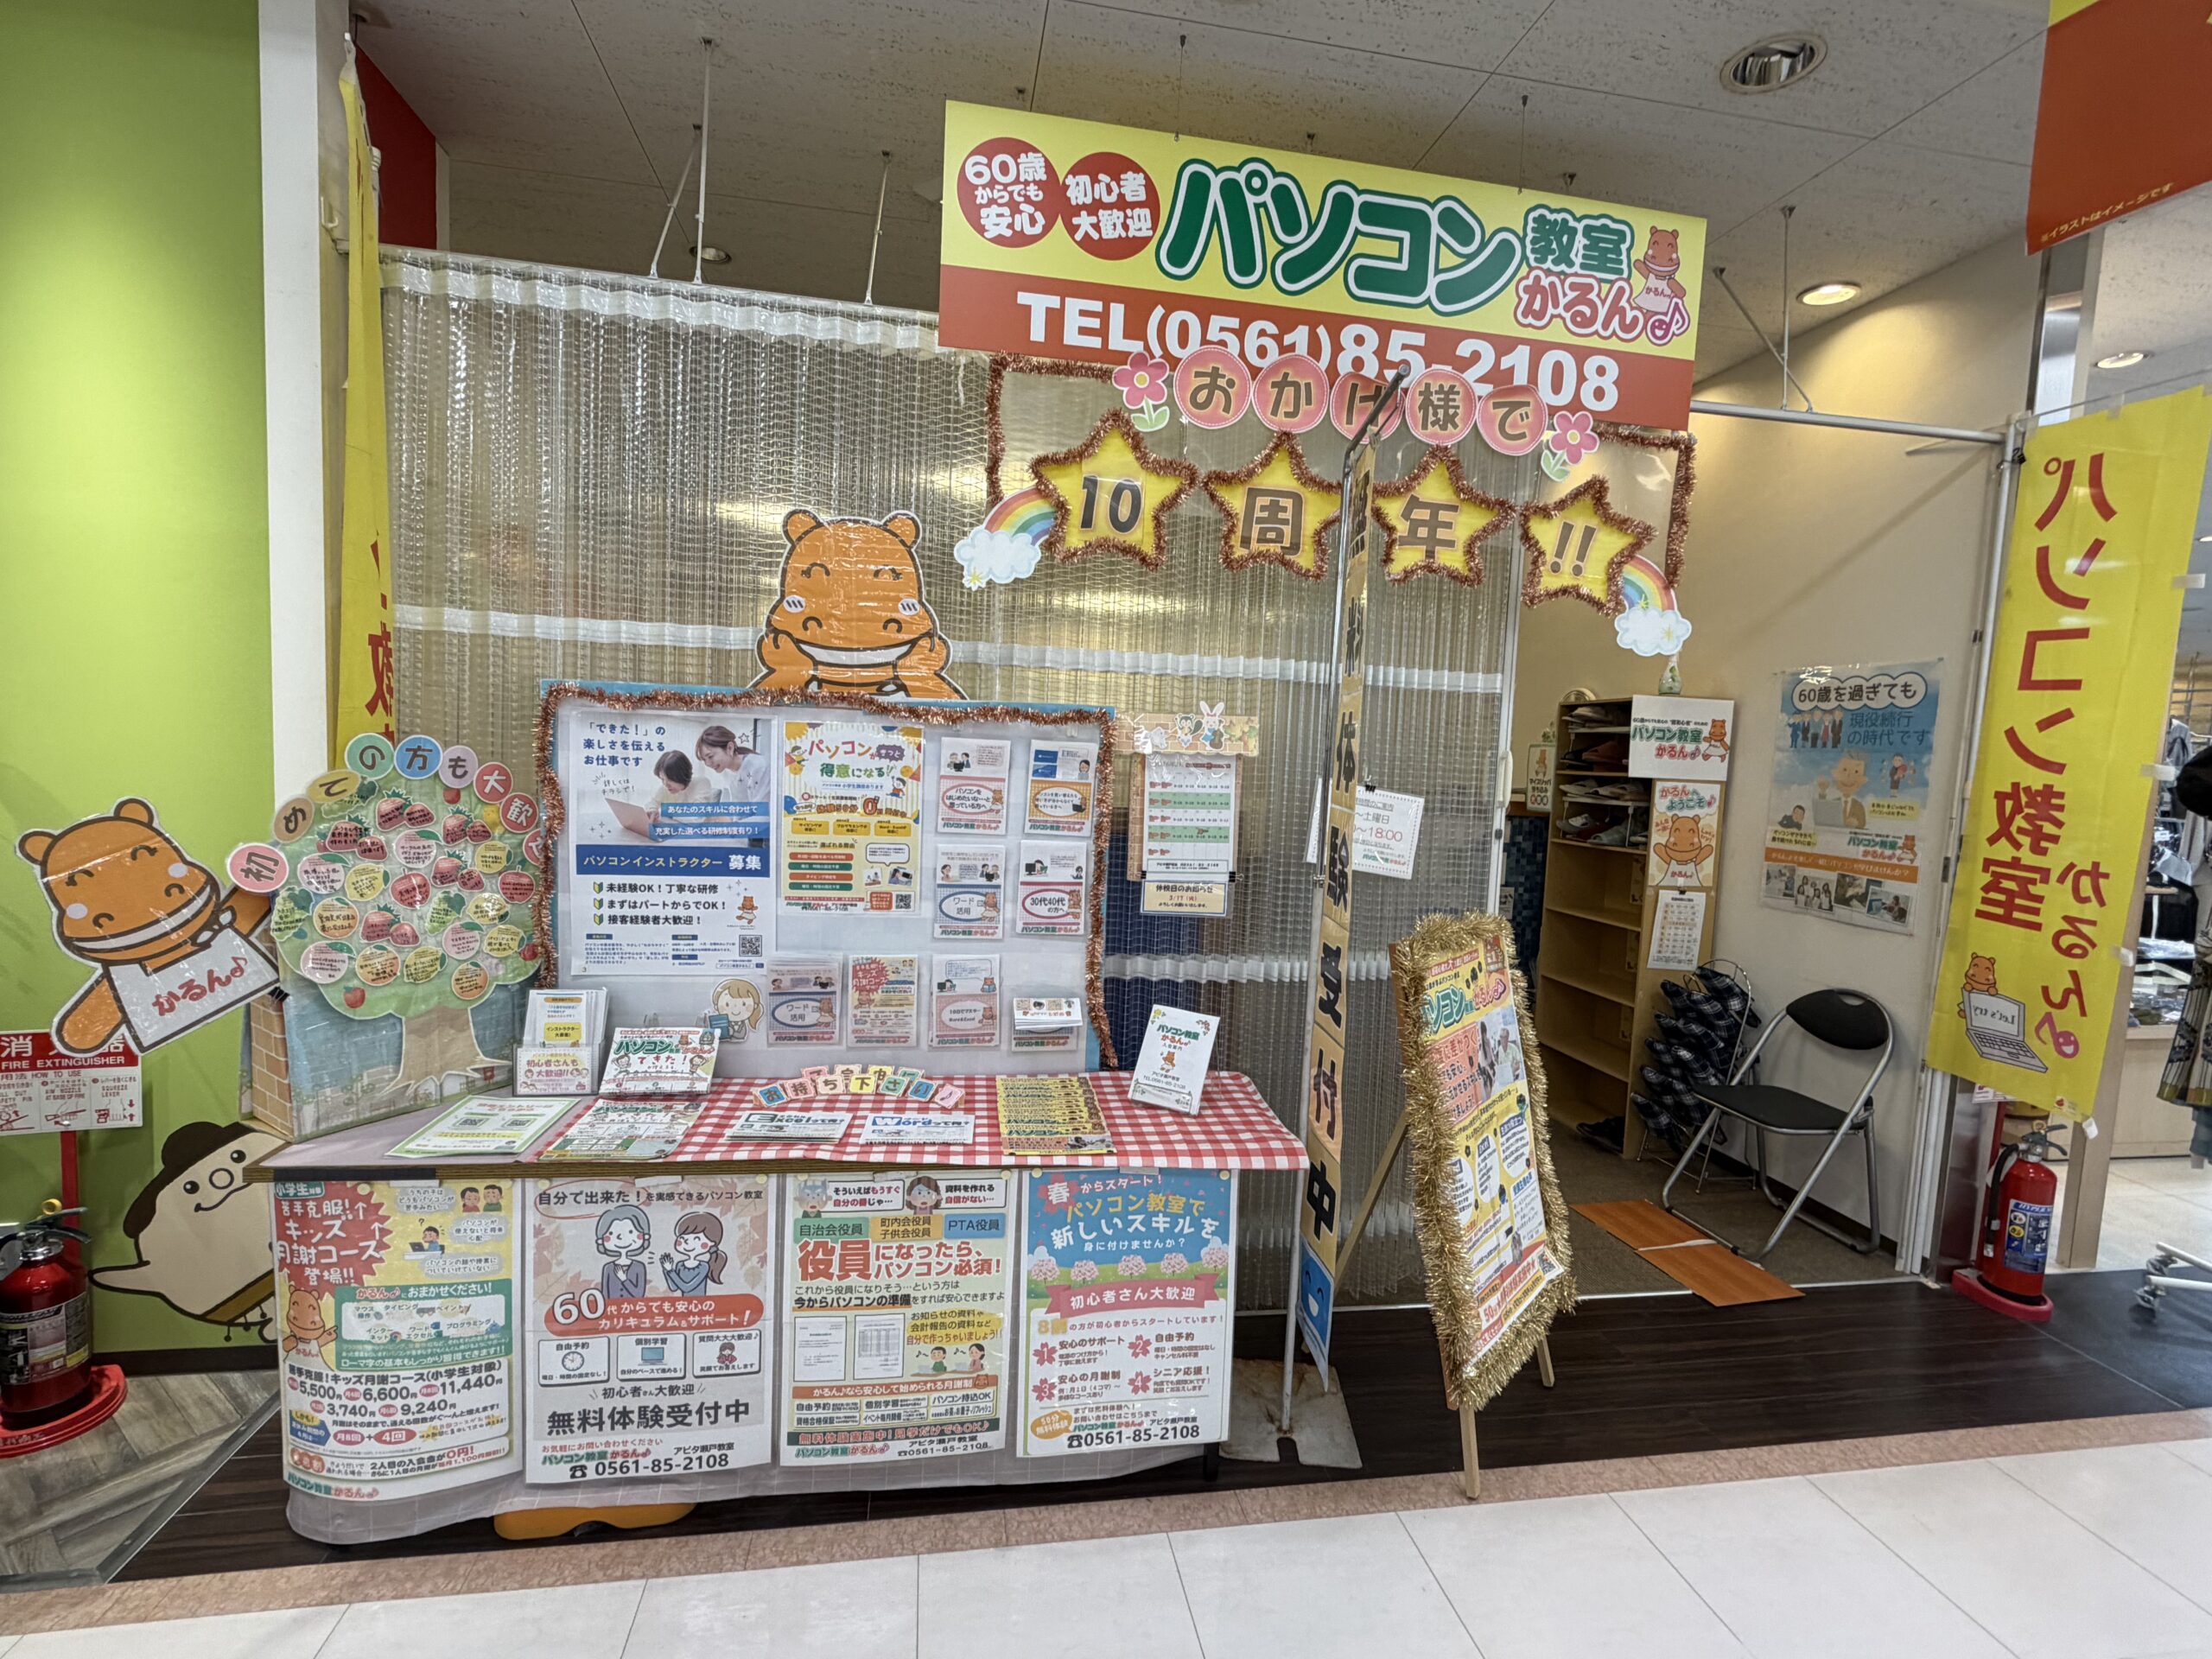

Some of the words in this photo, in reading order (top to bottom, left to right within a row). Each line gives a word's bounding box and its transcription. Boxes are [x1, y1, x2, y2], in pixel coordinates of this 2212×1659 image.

[964, 152, 1047, 185] 60歳
[974, 183, 1044, 205] からでも
[1065, 171, 1147, 207] 初心者
[980, 202, 1046, 239] 安心
[1071, 207, 1154, 242] 大歓迎
[1155, 156, 1523, 317] パソコン
[1523, 204, 1635, 284] 教室
[1798, 681, 1917, 704] 60歳を過ぎても
[1849, 711, 1914, 728] 現役続行
[1630, 725, 1704, 744] パソコン教室
[1847, 728, 1931, 747] の時代です
[583, 738, 666, 753] 楽しさを伝える
[583, 755, 643, 767] お仕事です
[667, 804, 759, 815] あなたのスキルに合わせて
[583, 855, 723, 868] パソコンインストラクター
[728, 855, 762, 871] 募集
[953, 897, 975, 906] ワード
[1030, 897, 1066, 907] 30代40代
[1156, 1024, 1201, 1041] パソコン教室
[613, 1039, 672, 1055] パソコン
[2, 1060, 30, 1071] FIRE
[36, 1056, 125, 1069] EXTINGUISHER
[526, 1059, 579, 1068] 初心者さんも
[833, 1185, 901, 1196] そういえばもうすぐ
[944, 1183, 995, 1194] 資料を作れる
[1065, 1192, 1206, 1224] パソコン教室で
[284, 1214, 354, 1243] キッズ
[880, 1216, 932, 1227] 町内会役員
[947, 1218, 1001, 1232] PTA役員
[799, 1223, 864, 1237] 自治会役員
[880, 1227, 932, 1239] 子供会役員
[1050, 1212, 1220, 1251] 新しいスキルを
[276, 1240, 382, 1265] 月謝コース
[1083, 1238, 1186, 1252] 身に付けませんか？
[797, 1238, 873, 1281] 役員
[794, 1280, 960, 1295] これから役員になりそう…という方は
[1069, 1287, 1197, 1311] 初心者さん大歓迎
[911, 1309, 985, 1321] お知らせの資料や
[446, 1319, 492, 1330] プログラミング
[911, 1319, 992, 1332] 会計報告の資料など
[634, 1338, 668, 1346] 個別学習
[1058, 1336, 1125, 1351] 安心のサポート
[1154, 1332, 1196, 1344] 自由予約
[556, 1342, 590, 1351] 自由予約
[1058, 1370, 1122, 1385] 安心の月謝制
[362, 1386, 418, 1402] 6,600円
[439, 1374, 503, 1396] 11,440円
[601, 1383, 696, 1400] 初心者さん大歓迎
[865, 1399, 899, 1409] 個別学習
[931, 1391, 993, 1404] パソコン持込OK
[327, 1403, 376, 1418] 3,740円
[400, 1399, 456, 1416] 9,240円
[796, 1402, 831, 1412] 自由予約
[546, 1399, 750, 1437] 無料体験受付中
[541, 1438, 664, 1454] お気軽にお問い合わせください
[673, 1441, 735, 1456] アピタ瀬戸教室
[908, 1435, 979, 1448] アピタ瀬戸教室
